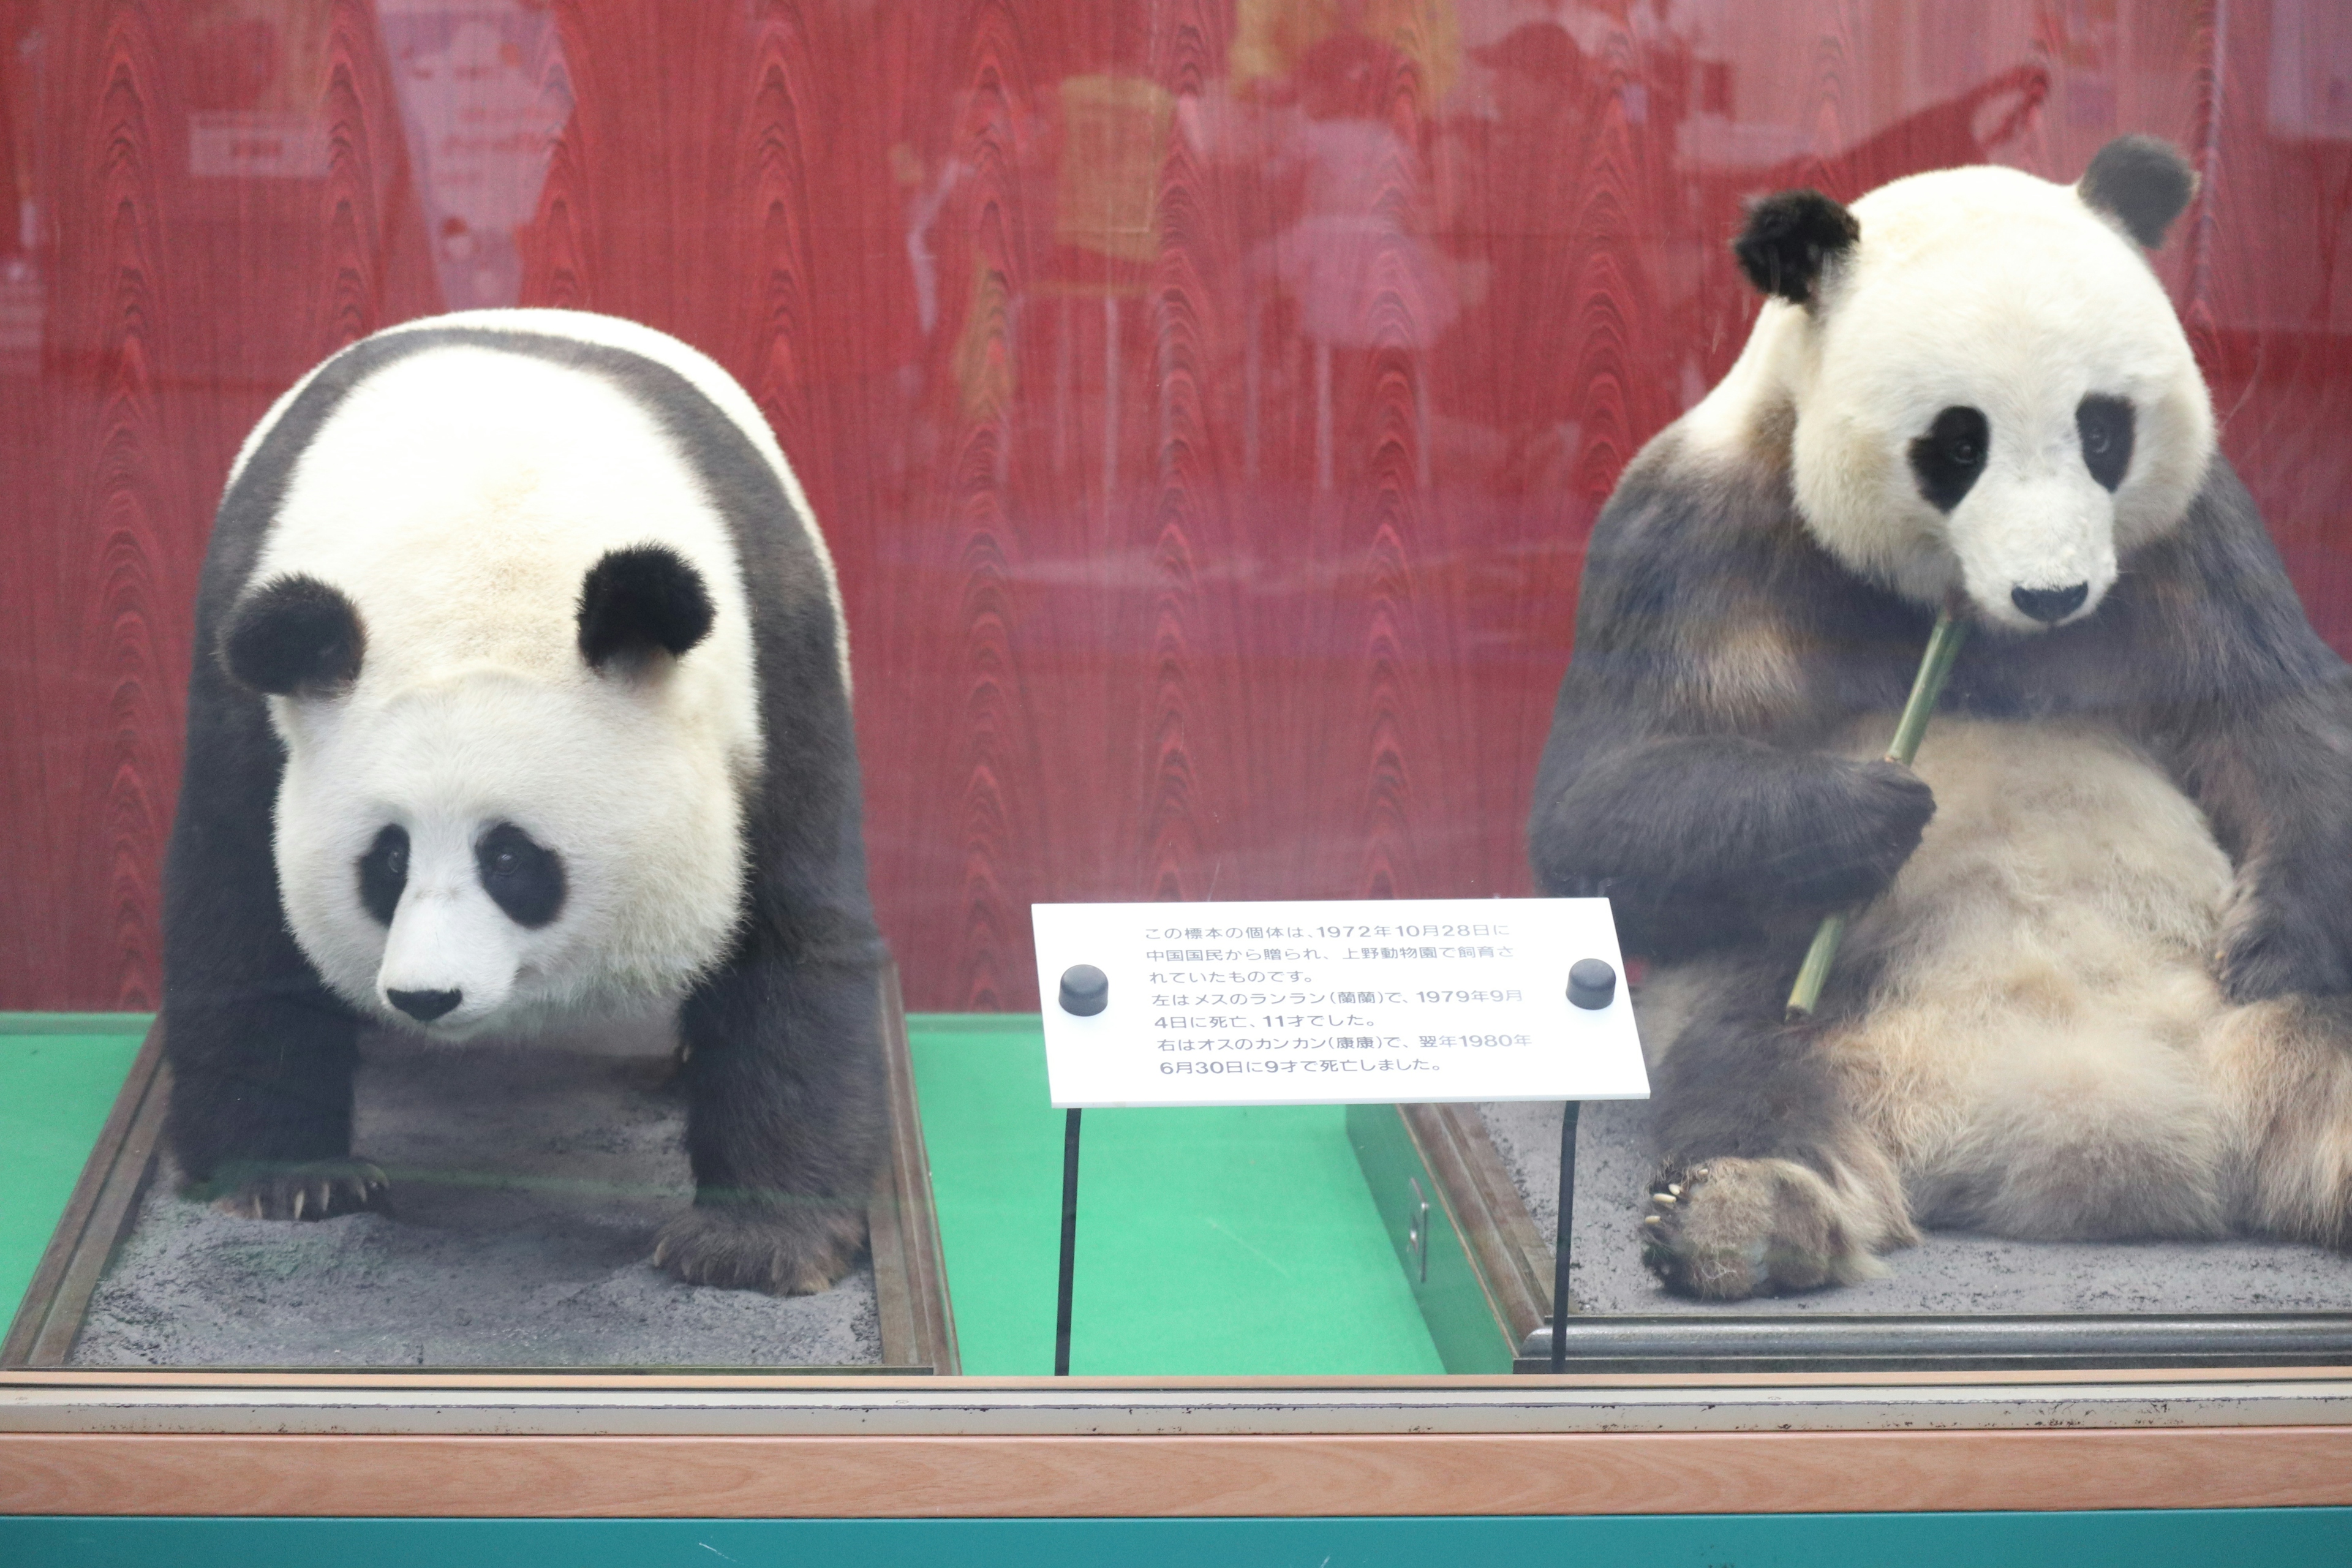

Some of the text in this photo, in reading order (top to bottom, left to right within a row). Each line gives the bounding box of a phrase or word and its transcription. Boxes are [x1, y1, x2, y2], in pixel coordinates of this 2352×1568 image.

[1150, 970, 1313, 984] れていたものです。
[1154, 1014, 1375, 1029] 4日に死亡、11才でした。
[1159, 1058, 1441, 1074] 6月30日に9才で死亡しました。
